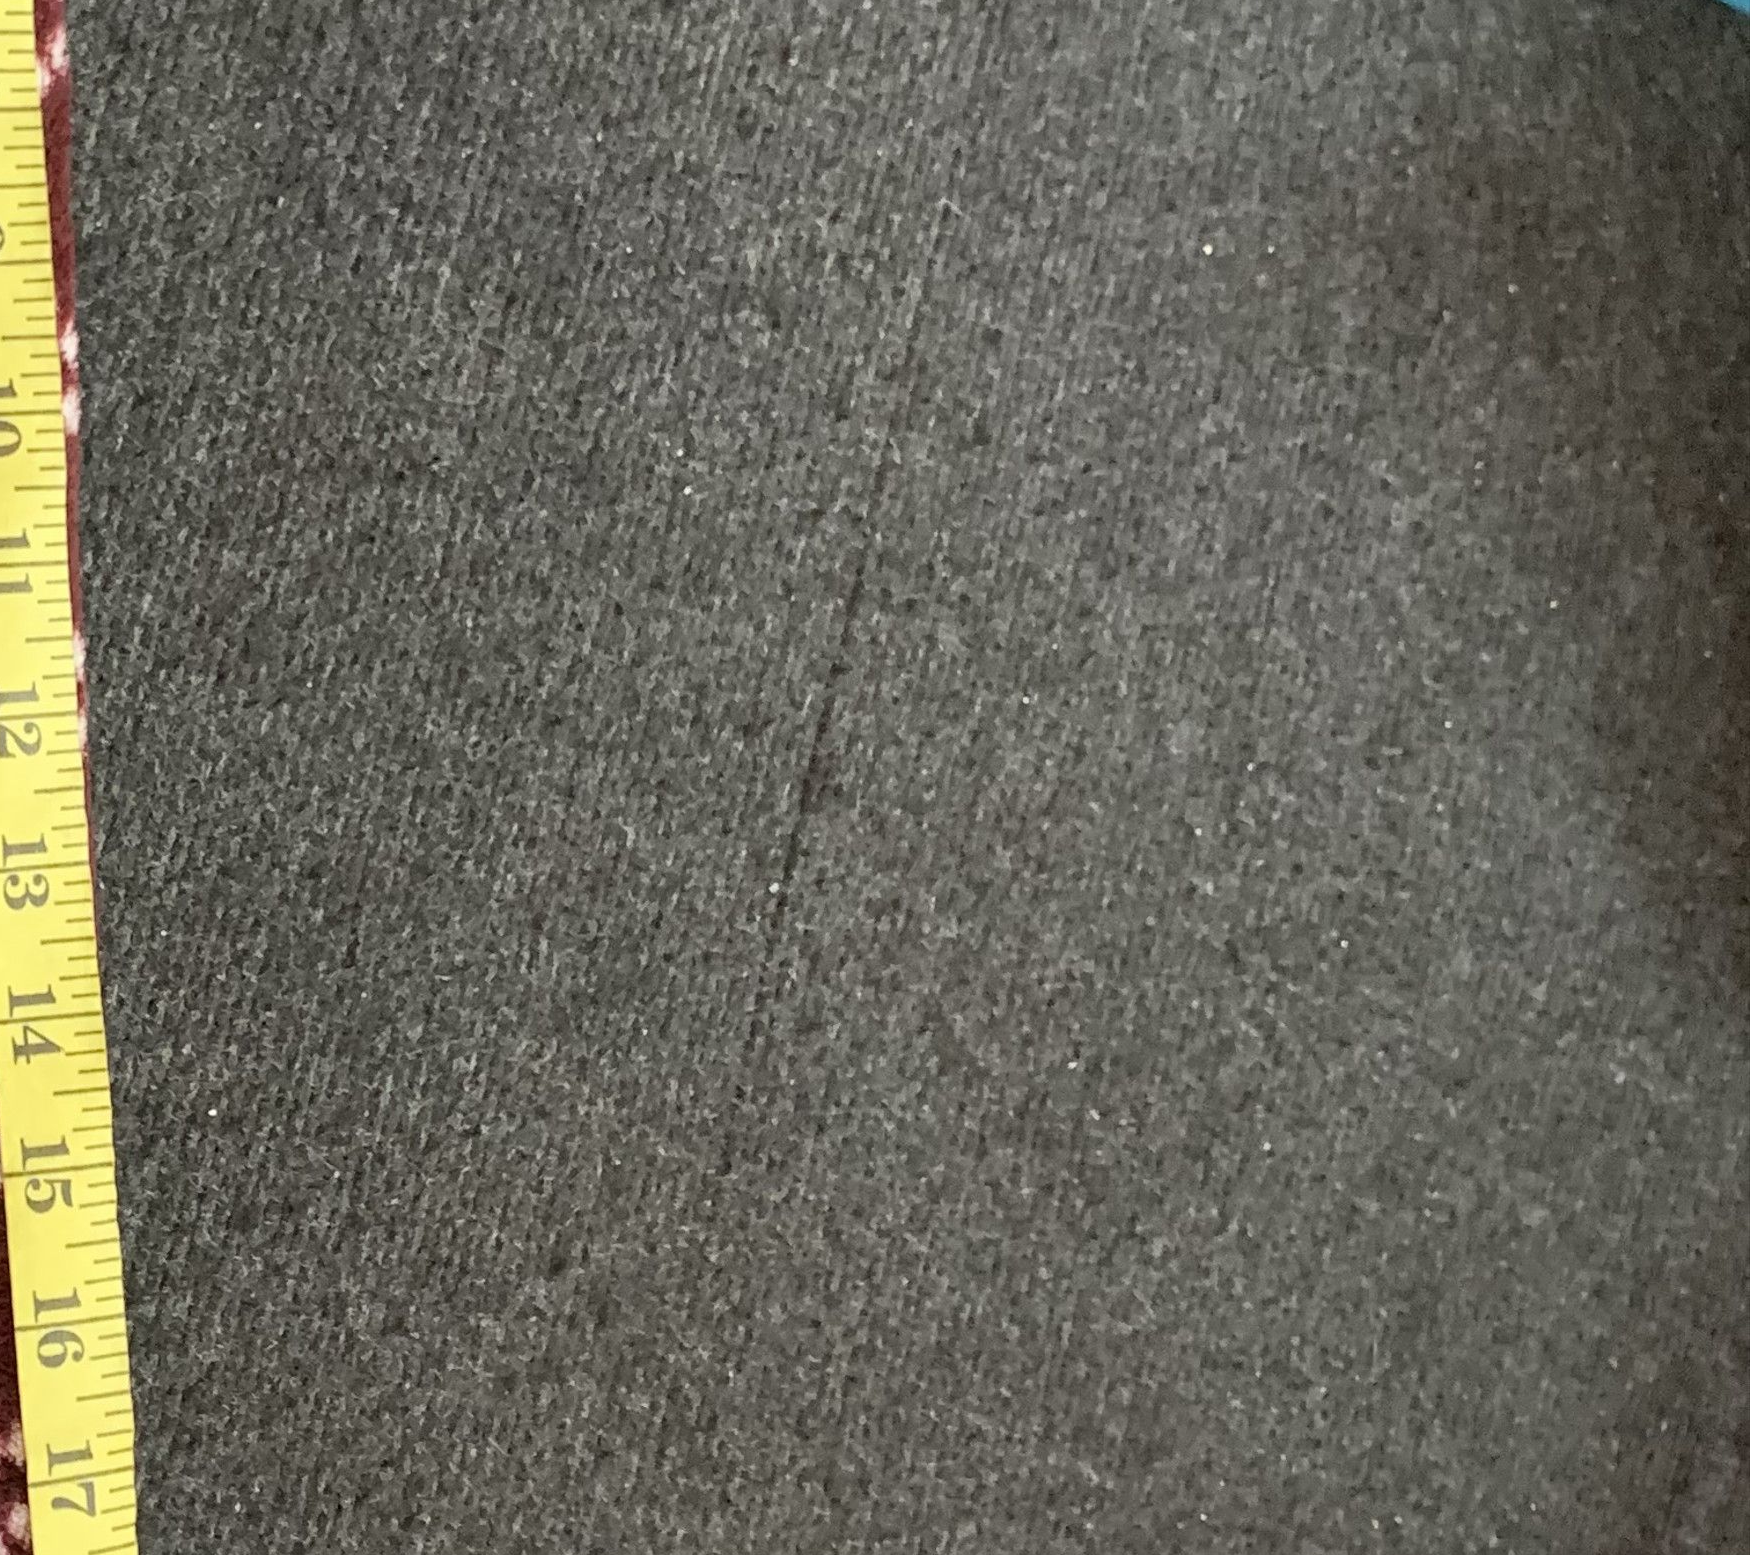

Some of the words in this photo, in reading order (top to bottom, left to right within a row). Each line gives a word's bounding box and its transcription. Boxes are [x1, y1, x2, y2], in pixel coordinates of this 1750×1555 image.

[1, 833, 50, 911] 13
[7, 984, 65, 1066] 14
[20, 1135, 73, 1214] 15
[33, 1287, 85, 1369] 16
[46, 1440, 96, 1518] 17
